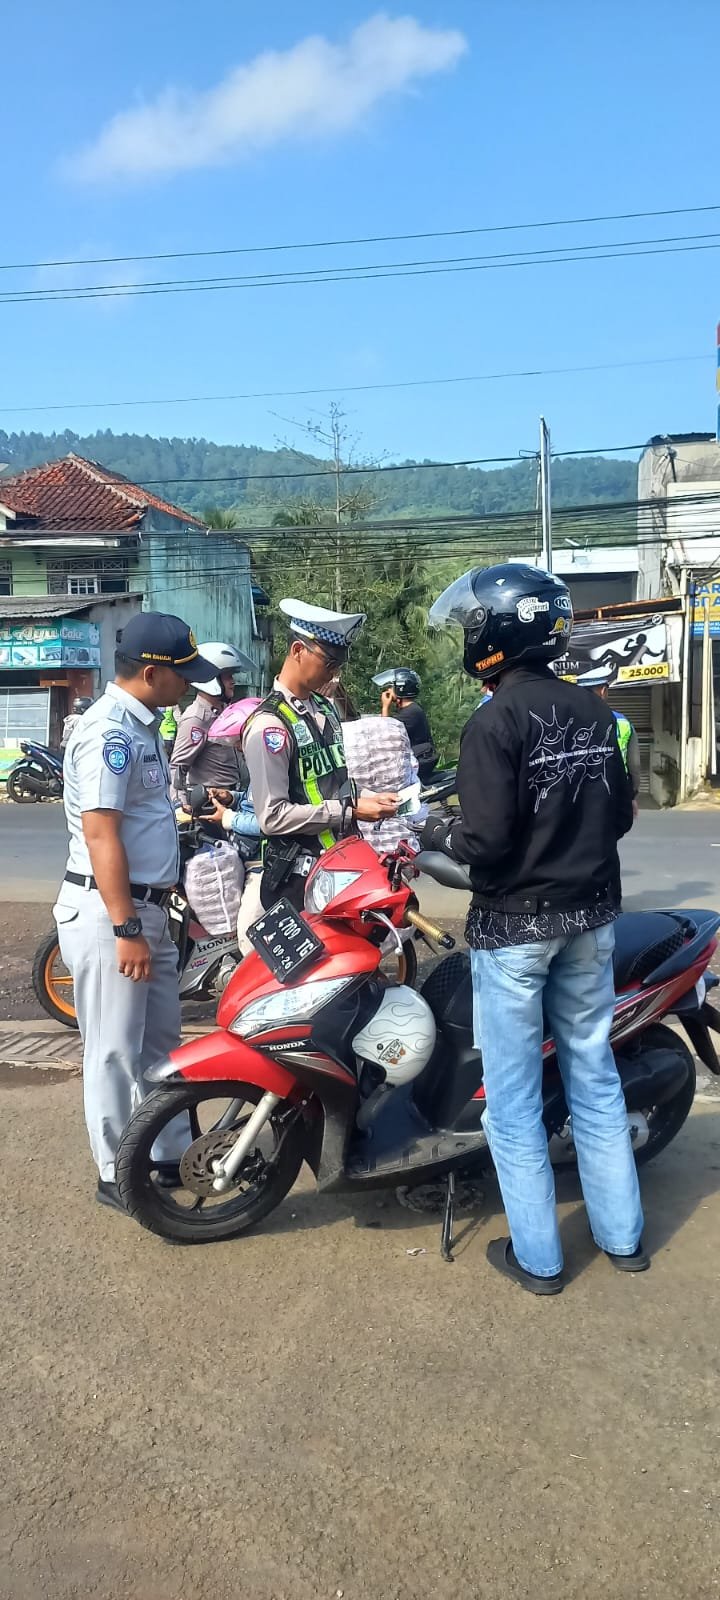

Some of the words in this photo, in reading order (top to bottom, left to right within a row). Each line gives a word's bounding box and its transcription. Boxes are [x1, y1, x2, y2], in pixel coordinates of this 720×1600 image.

[554, 661, 579, 672] NUM
[629, 666, 664, 678] 25.000
[302, 744, 346, 780] POLIS
[278, 916, 301, 940] 4709
[295, 938, 314, 957] TG
[269, 1041, 305, 1051] HONDA
